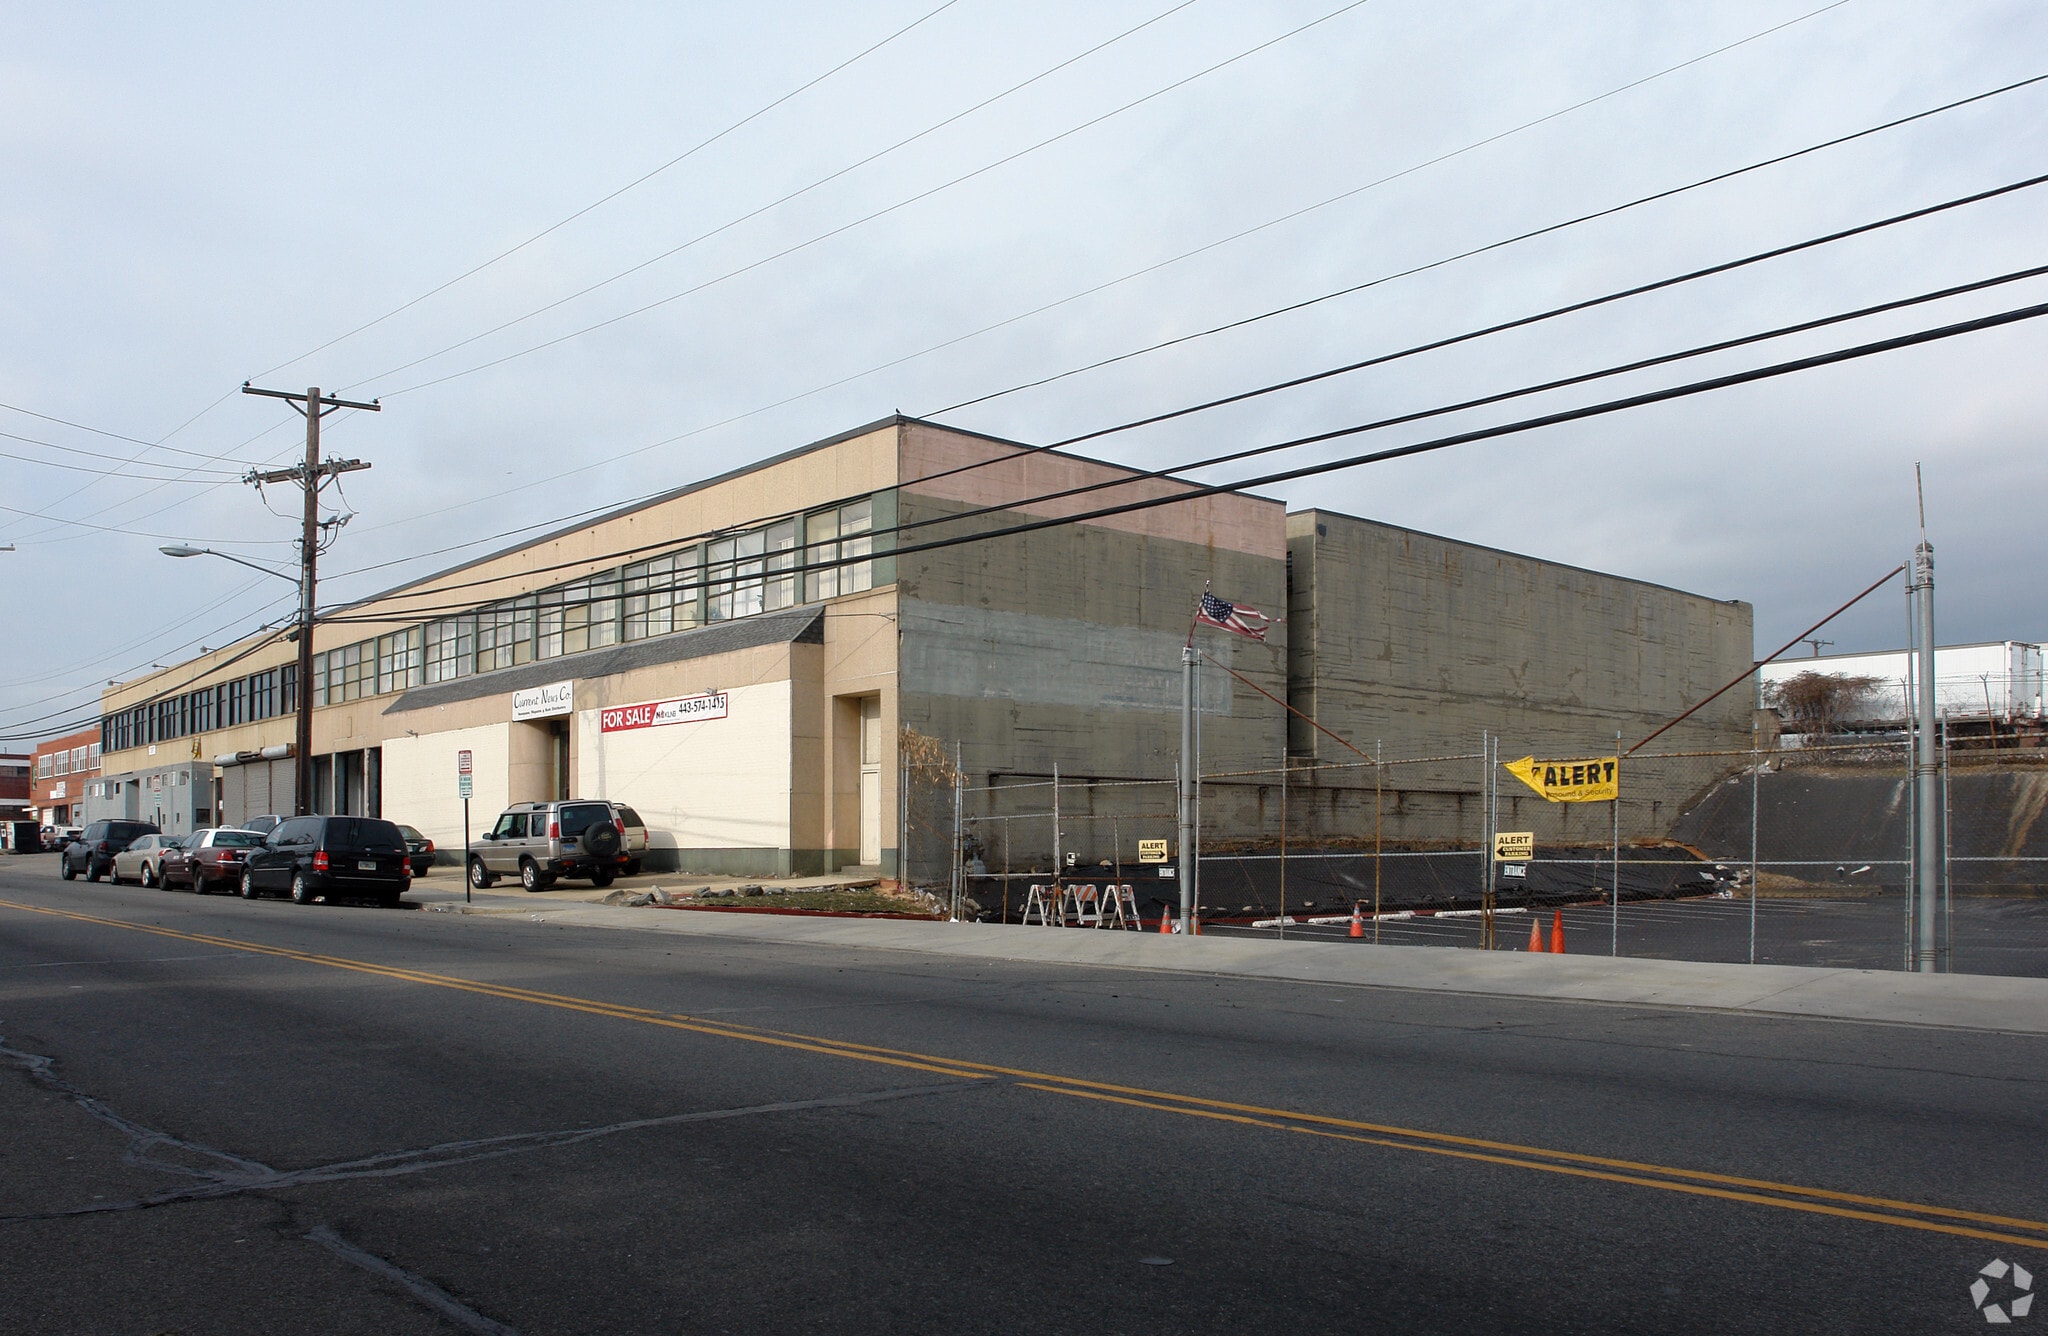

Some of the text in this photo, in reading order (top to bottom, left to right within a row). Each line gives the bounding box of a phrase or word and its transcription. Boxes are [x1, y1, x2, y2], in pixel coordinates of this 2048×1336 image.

[514, 685, 571, 709] Current News Co.
[603, 706, 650, 729] FOR SALE
[1544, 762, 1615, 787] ALERT
[1585, 788, 1613, 796] Security
[1497, 836, 1530, 844] ALERT
